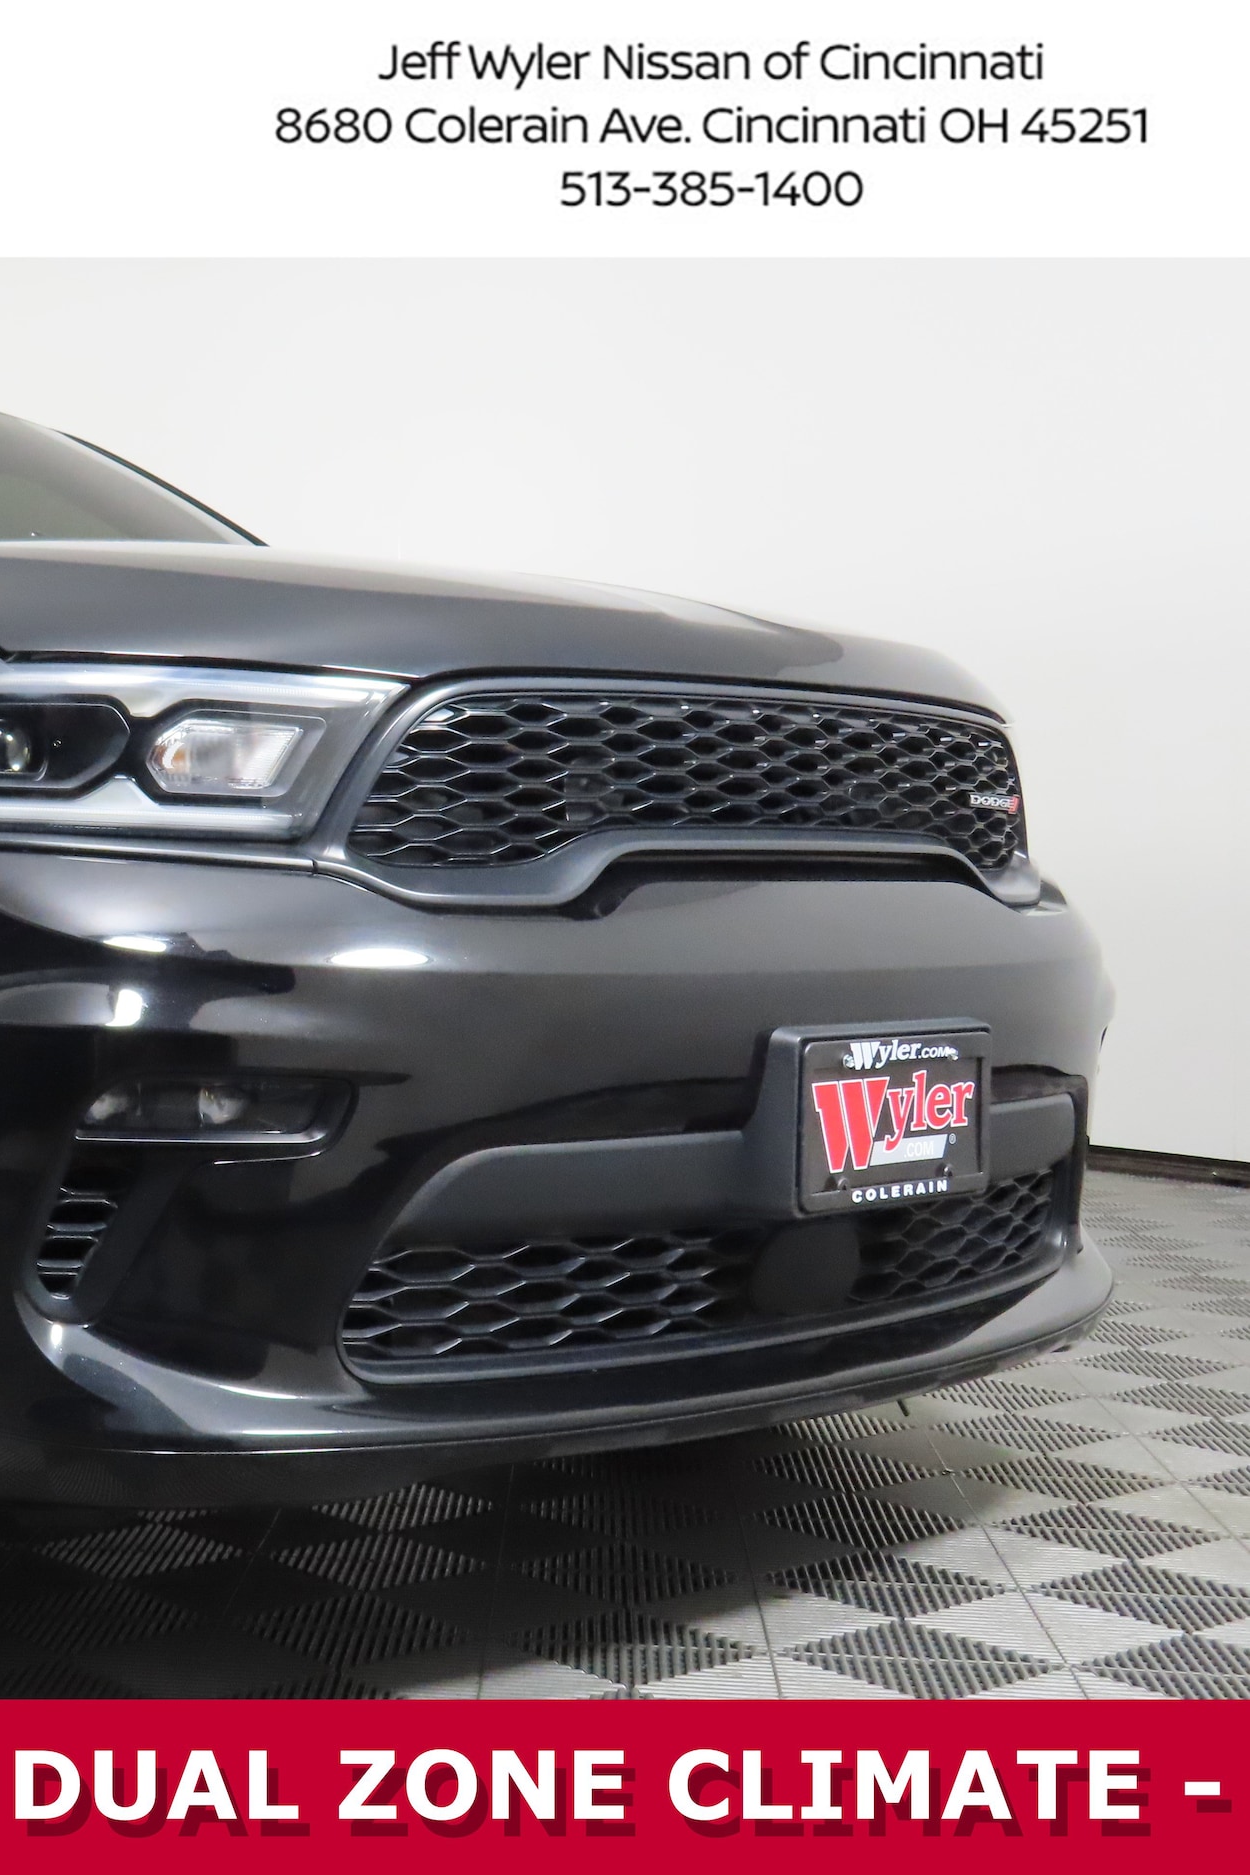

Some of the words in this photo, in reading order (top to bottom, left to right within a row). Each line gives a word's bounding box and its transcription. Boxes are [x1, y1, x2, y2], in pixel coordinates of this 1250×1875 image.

[970, 794, 1014, 809] DODGE
[812, 1070, 976, 1174] Wyler
[851, 1179, 948, 1203] COLERAIN
